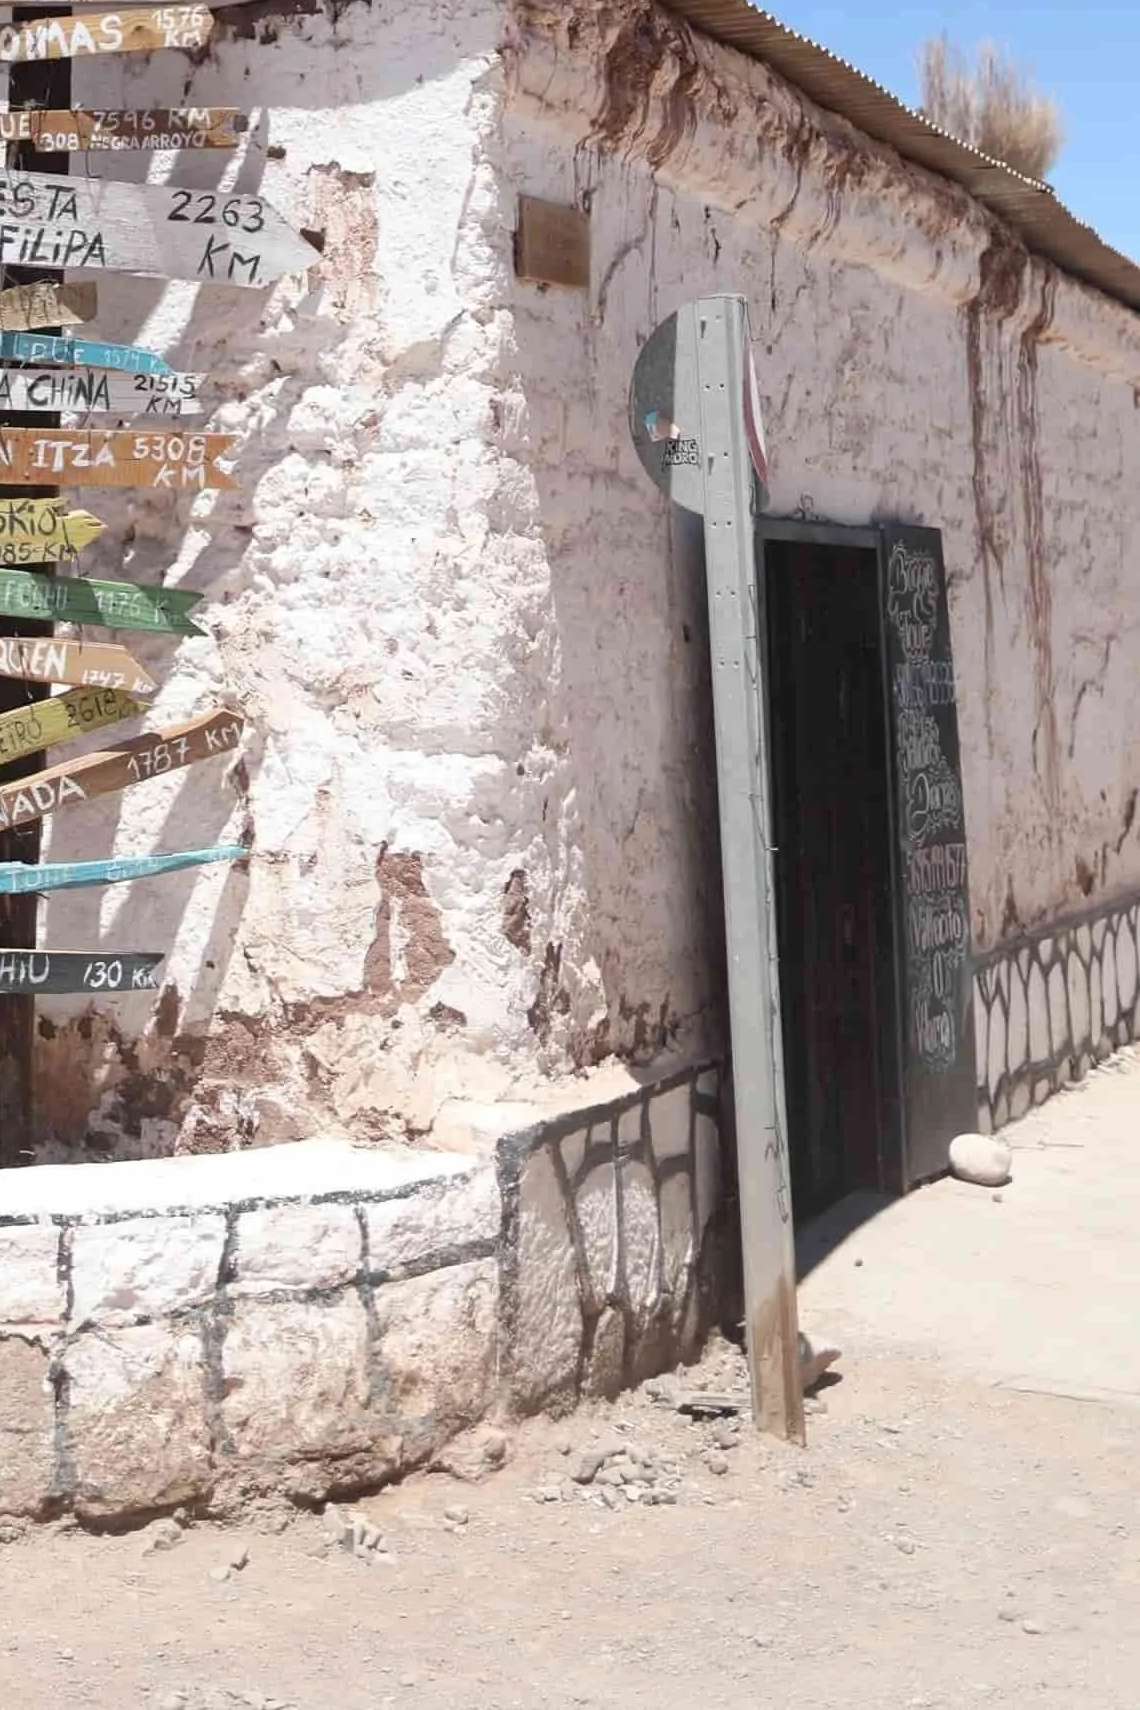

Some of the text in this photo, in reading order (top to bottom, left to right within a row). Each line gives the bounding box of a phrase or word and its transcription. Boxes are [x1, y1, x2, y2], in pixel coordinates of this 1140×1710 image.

[151, 8, 204, 31] 1576
[93, 110, 157, 133] 7596
[39, 132, 79, 152] 308
[167, 190, 265, 232] 2263
[146, 395, 182, 414] KM
[153, 463, 205, 489] KM
[126, 739, 188, 782] 1787
[204, 722, 241, 753] KM
[83, 960, 123, 988] 130
